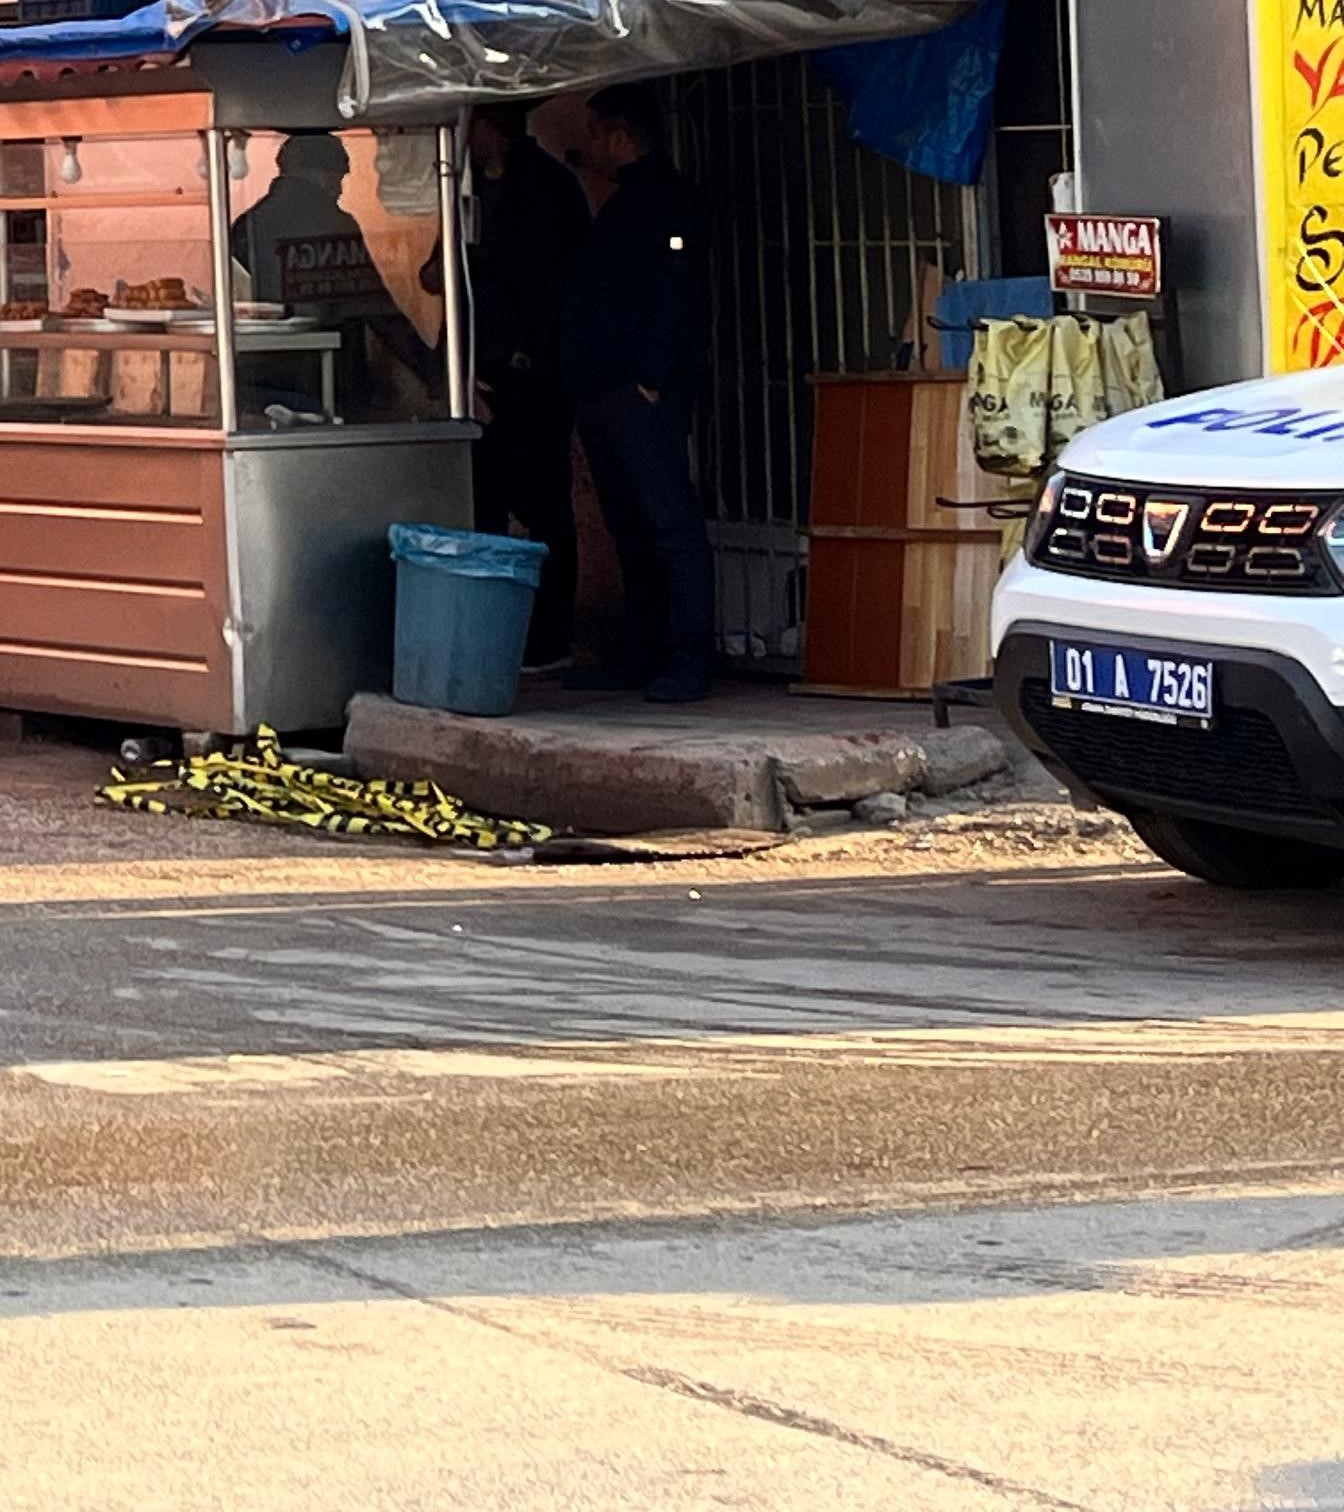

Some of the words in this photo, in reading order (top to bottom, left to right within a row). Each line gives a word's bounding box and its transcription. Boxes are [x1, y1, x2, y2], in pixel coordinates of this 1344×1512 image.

[1076, 219, 1153, 256] MANGA
[1066, 647, 1094, 693] 01
[1115, 653, 1130, 699] A
[1147, 658, 1207, 710] 7526
